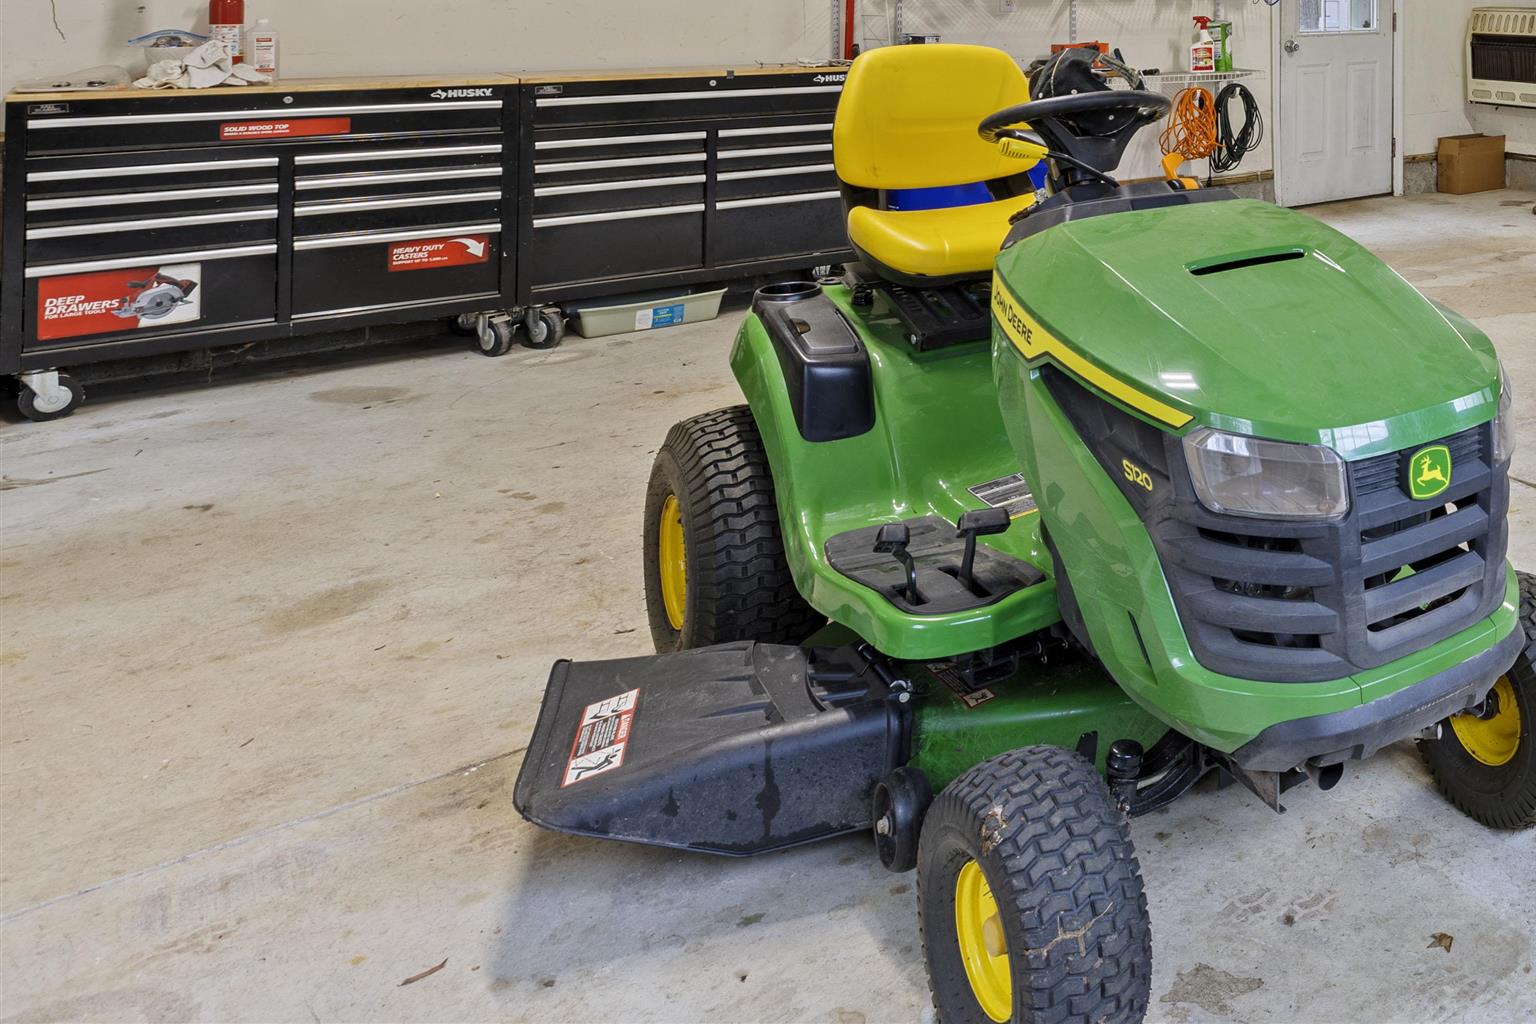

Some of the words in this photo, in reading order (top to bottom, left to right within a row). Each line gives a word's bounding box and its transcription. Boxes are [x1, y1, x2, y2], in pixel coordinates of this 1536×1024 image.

[447, 88, 493, 98] HUSKY
[393, 246, 421, 254] HEAVY
[422, 244, 445, 252] DUTY
[392, 251, 429, 261] CASTERS
[44, 295, 85, 308] DEEP
[44, 299, 120, 316] DRAWERS
[60, 311, 83, 319] LARGE
[1007, 304, 1033, 346] DEERE
[1122, 459, 1153, 491] S120
